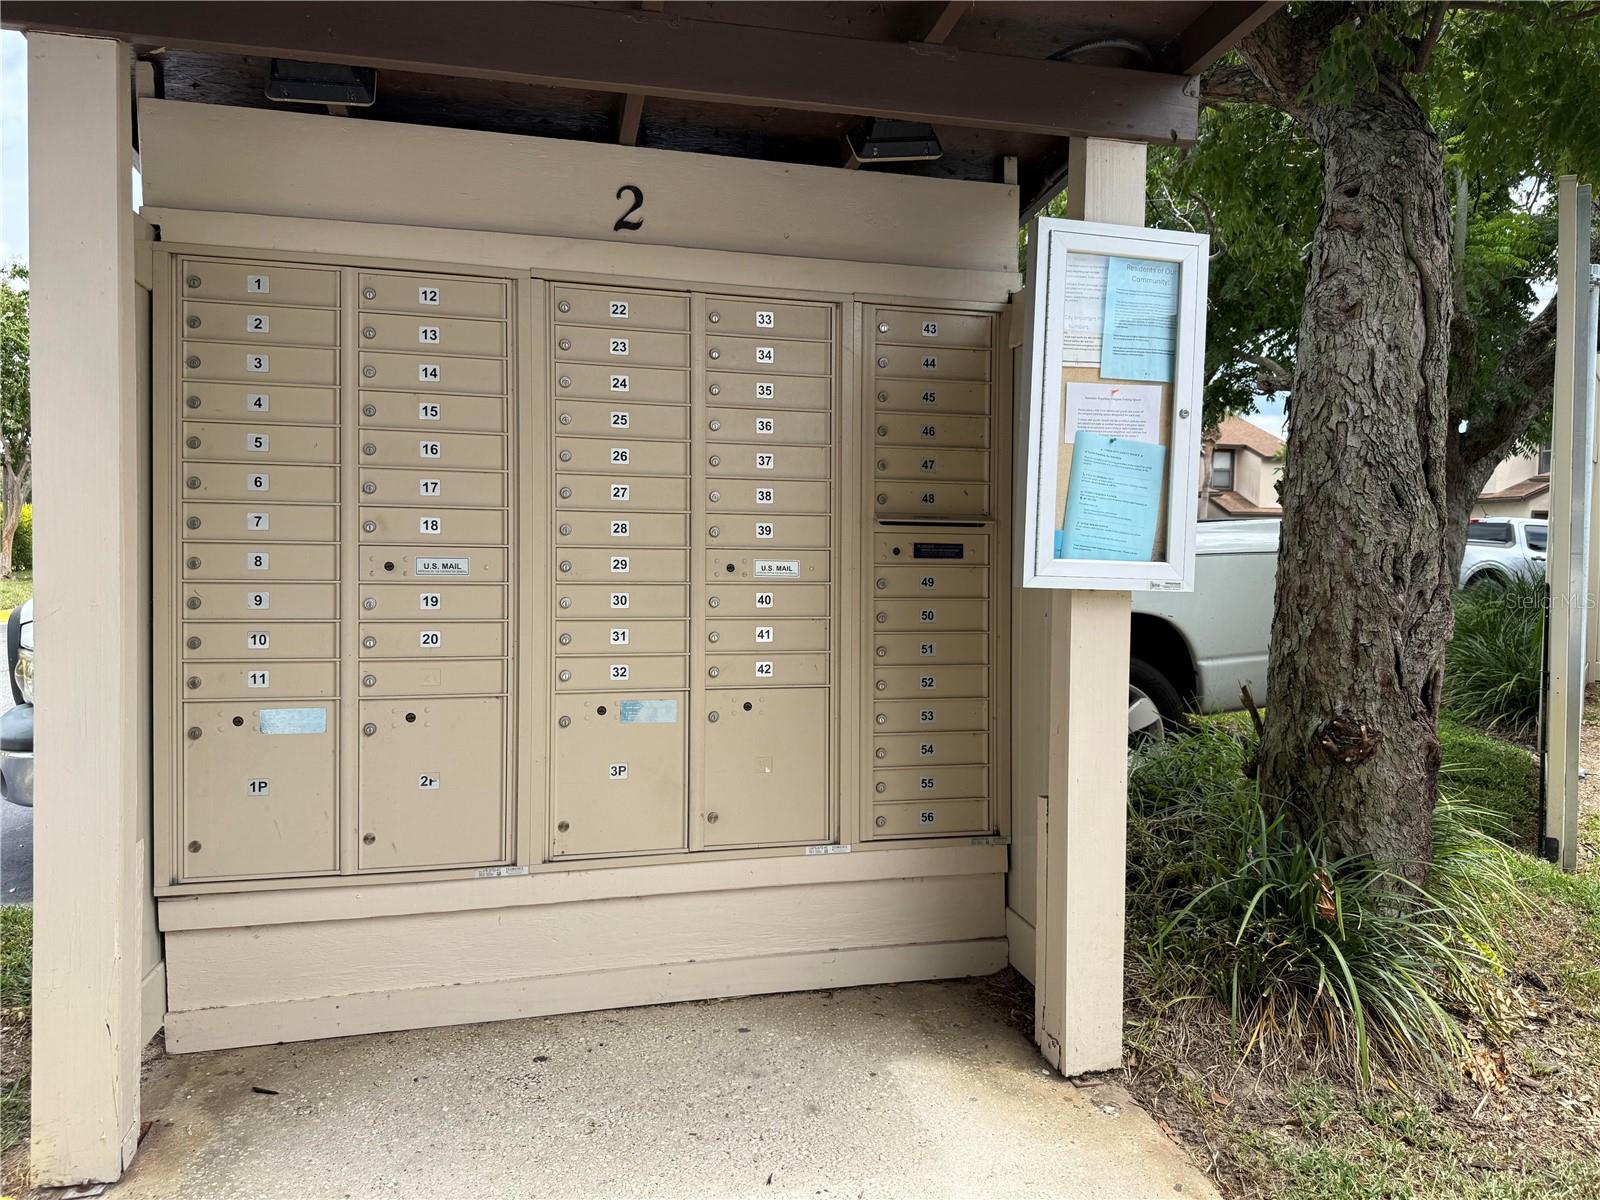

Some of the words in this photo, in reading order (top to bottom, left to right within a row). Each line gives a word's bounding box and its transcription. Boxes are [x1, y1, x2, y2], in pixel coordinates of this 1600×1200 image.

[614, 185, 644, 232] 2
[1127, 263, 1156, 274] Residents
[1157, 267, 1164, 275] of
[254, 278, 261, 290] 1
[421, 290, 437, 302] 12
[611, 303, 627, 316] 22
[254, 317, 263, 330] 2
[758, 313, 772, 325] 33
[421, 328, 438, 341] 13
[923, 323, 937, 334] 43
[612, 340, 627, 353] 23
[758, 349, 772, 361] 34
[254, 357, 263, 369] 3
[922, 358, 936, 369] 44
[422, 367, 438, 379] 14
[612, 377, 628, 389] 24
[758, 385, 772, 396] 35
[253, 396, 263, 409] 4
[922, 391, 936, 403] 45
[422, 405, 438, 417] 15
[612, 414, 628, 426] 25
[758, 420, 772, 432] 36
[922, 426, 936, 437] 46
[254, 436, 263, 449] 5
[422, 443, 439, 456] 16
[612, 450, 628, 462] 26
[758, 455, 772, 466] 37
[921, 459, 936, 470] 47
[254, 476, 263, 488] 6
[422, 481, 439, 493] 17
[612, 486, 628, 498] 27
[758, 490, 772, 501] 38
[921, 493, 935, 504] 48
[253, 515, 263, 527] 7
[422, 519, 439, 531] 18
[612, 522, 628, 534] 28
[758, 525, 772, 536] 39
[254, 555, 263, 567] 8
[423, 562, 440, 570] U.S.
[441, 562, 462, 570] MAIL
[612, 558, 628, 570] 29
[760, 564, 775, 572] U.S.
[776, 564, 793, 572] MAIL
[920, 577, 935, 588] 49
[254, 594, 263, 607] 9
[422, 595, 439, 607] 19
[612, 595, 628, 606] 30
[757, 594, 772, 605] 40
[921, 610, 934, 621] 50
[250, 633, 267, 646] 10
[422, 633, 439, 645] 20
[612, 630, 627, 642] 31
[757, 629, 771, 640] 41
[921, 644, 934, 654] 51
[612, 666, 627, 678] 32
[757, 663, 772, 674] 42
[250, 673, 266, 685] 11
[921, 677, 934, 688] 52
[921, 710, 934, 721] 53
[921, 744, 934, 755] 54
[610, 765, 627, 777] 3P
[249, 781, 268, 793] 1P
[921, 778, 934, 789] 55
[921, 811, 934, 823] 56
